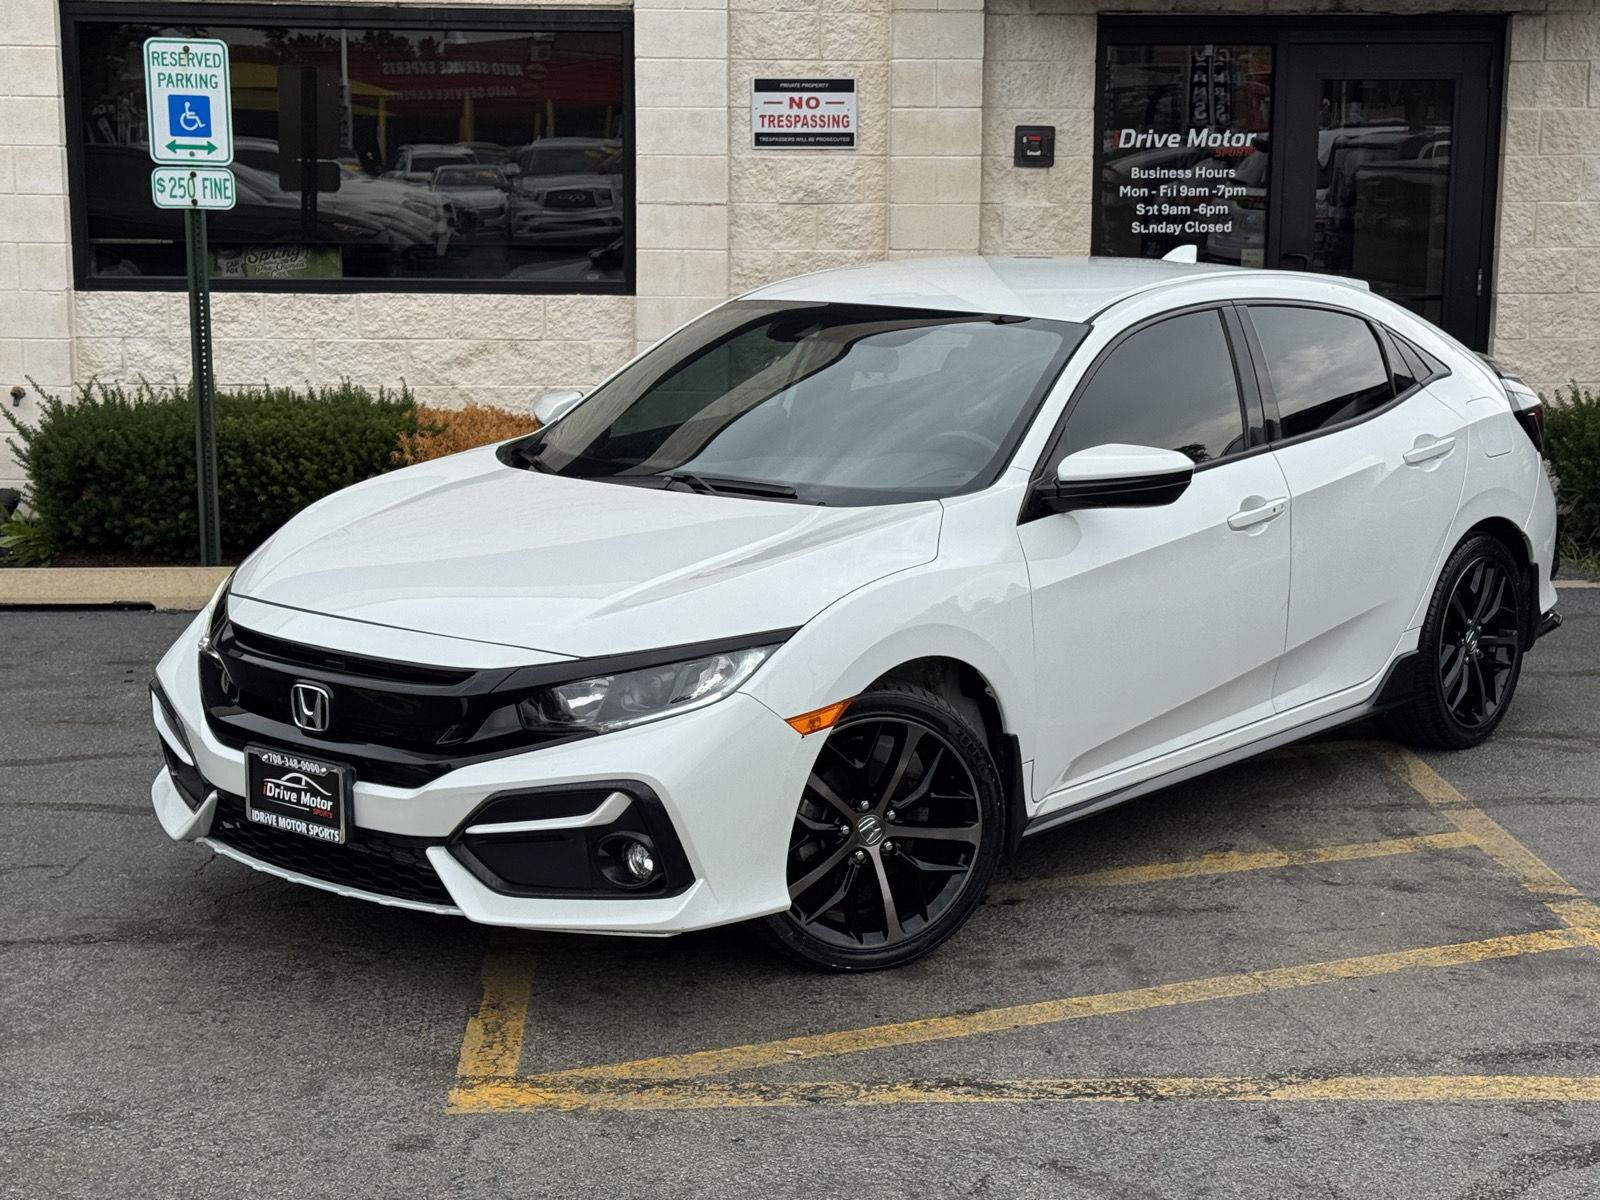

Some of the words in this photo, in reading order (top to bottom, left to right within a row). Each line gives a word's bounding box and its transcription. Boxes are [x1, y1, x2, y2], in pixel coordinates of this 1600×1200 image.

[151, 51, 222, 68] RESERVED
[157, 72, 219, 89] PARKING
[788, 96, 821, 110] NO
[759, 114, 850, 129] TRESPASSING
[1187, 128, 1257, 148] Motor
[1131, 167, 1192, 179] Business
[1195, 167, 1236, 179] Hours
[157, 177, 196, 199] $250
[202, 177, 231, 200] FINE
[1119, 186, 1149, 197] Mon
[1160, 186, 1177, 197] Fri
[1180, 186, 1209, 197] 9am
[1161, 204, 1190, 215] 9am
[1184, 221, 1232, 233] Closed
[246, 246, 302, 264] Spring
[263, 782, 298, 802] iDrive
[300, 791, 333, 811] Motor
[279, 816, 307, 834] MOTOR
[309, 824, 339, 842] SPORTS
